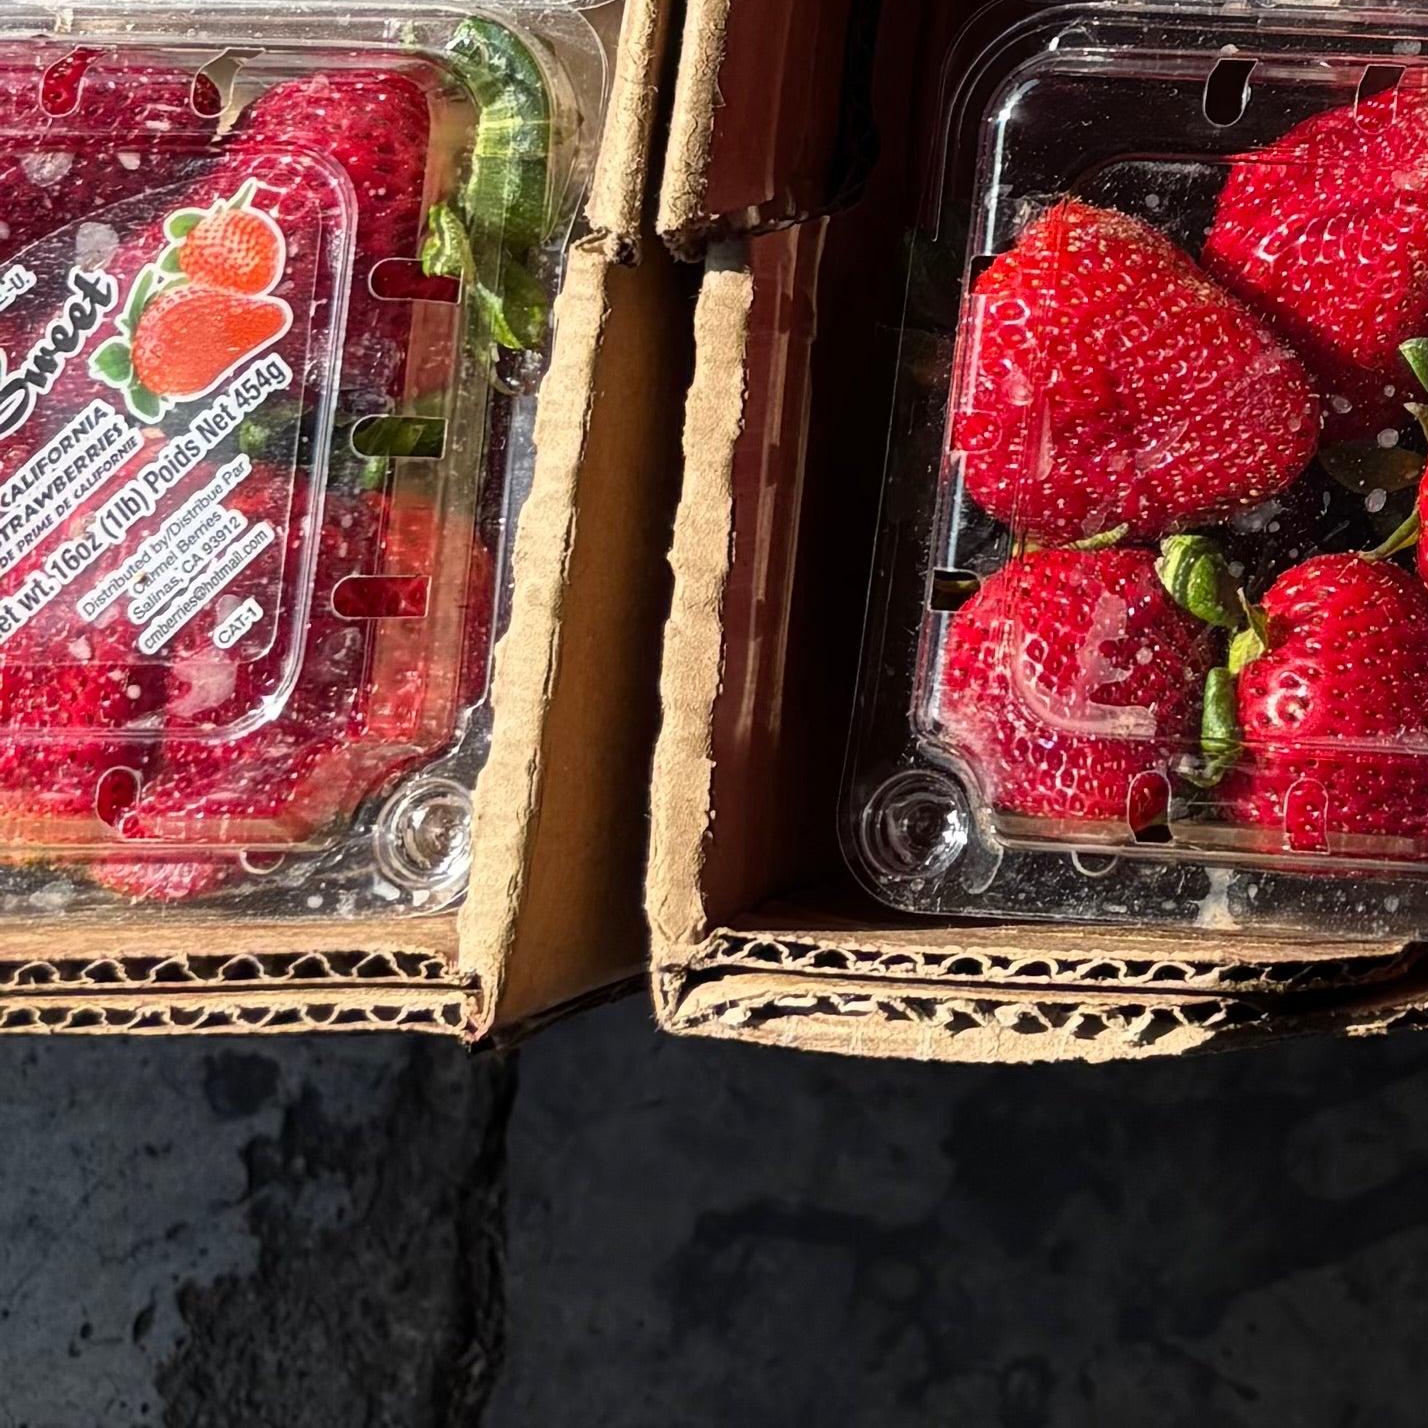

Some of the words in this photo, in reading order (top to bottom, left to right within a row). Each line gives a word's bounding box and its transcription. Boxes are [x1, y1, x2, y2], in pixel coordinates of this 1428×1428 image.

[17, 577, 56, 612] wt.
[50, 531, 103, 580] 16oz
[98, 486, 150, 540] (1lb)
[141, 439, 202, 495] Poids
[195, 402, 238, 445] Net
[234, 360, 287, 410] 454g
[218, 605, 257, 645] CAT-1
